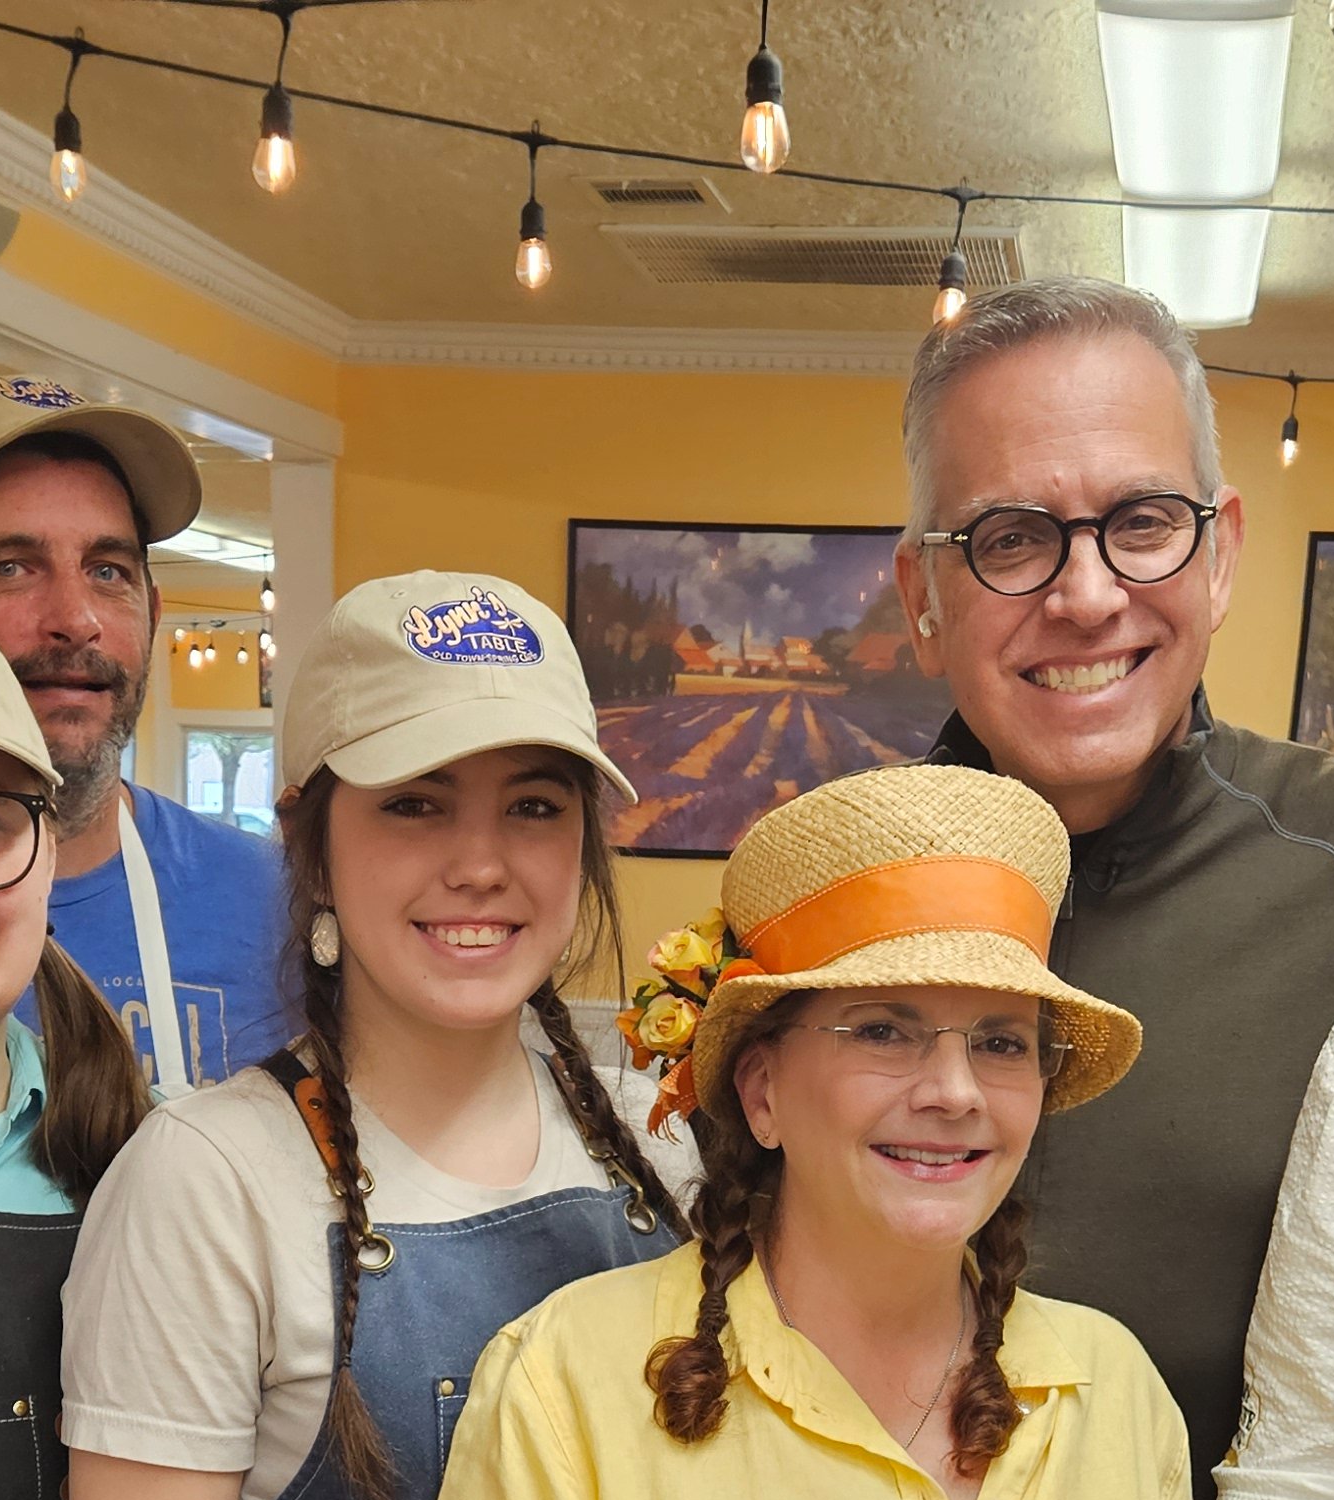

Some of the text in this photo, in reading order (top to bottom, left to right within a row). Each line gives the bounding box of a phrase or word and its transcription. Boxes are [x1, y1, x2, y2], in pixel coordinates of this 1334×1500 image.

[403, 586, 508, 649] Lynn's
[468, 635, 527, 654] TABLE
[432, 651, 452, 660] OLD
[455, 653, 484, 662] TOWN
[102, 976, 144, 987] LOCA
